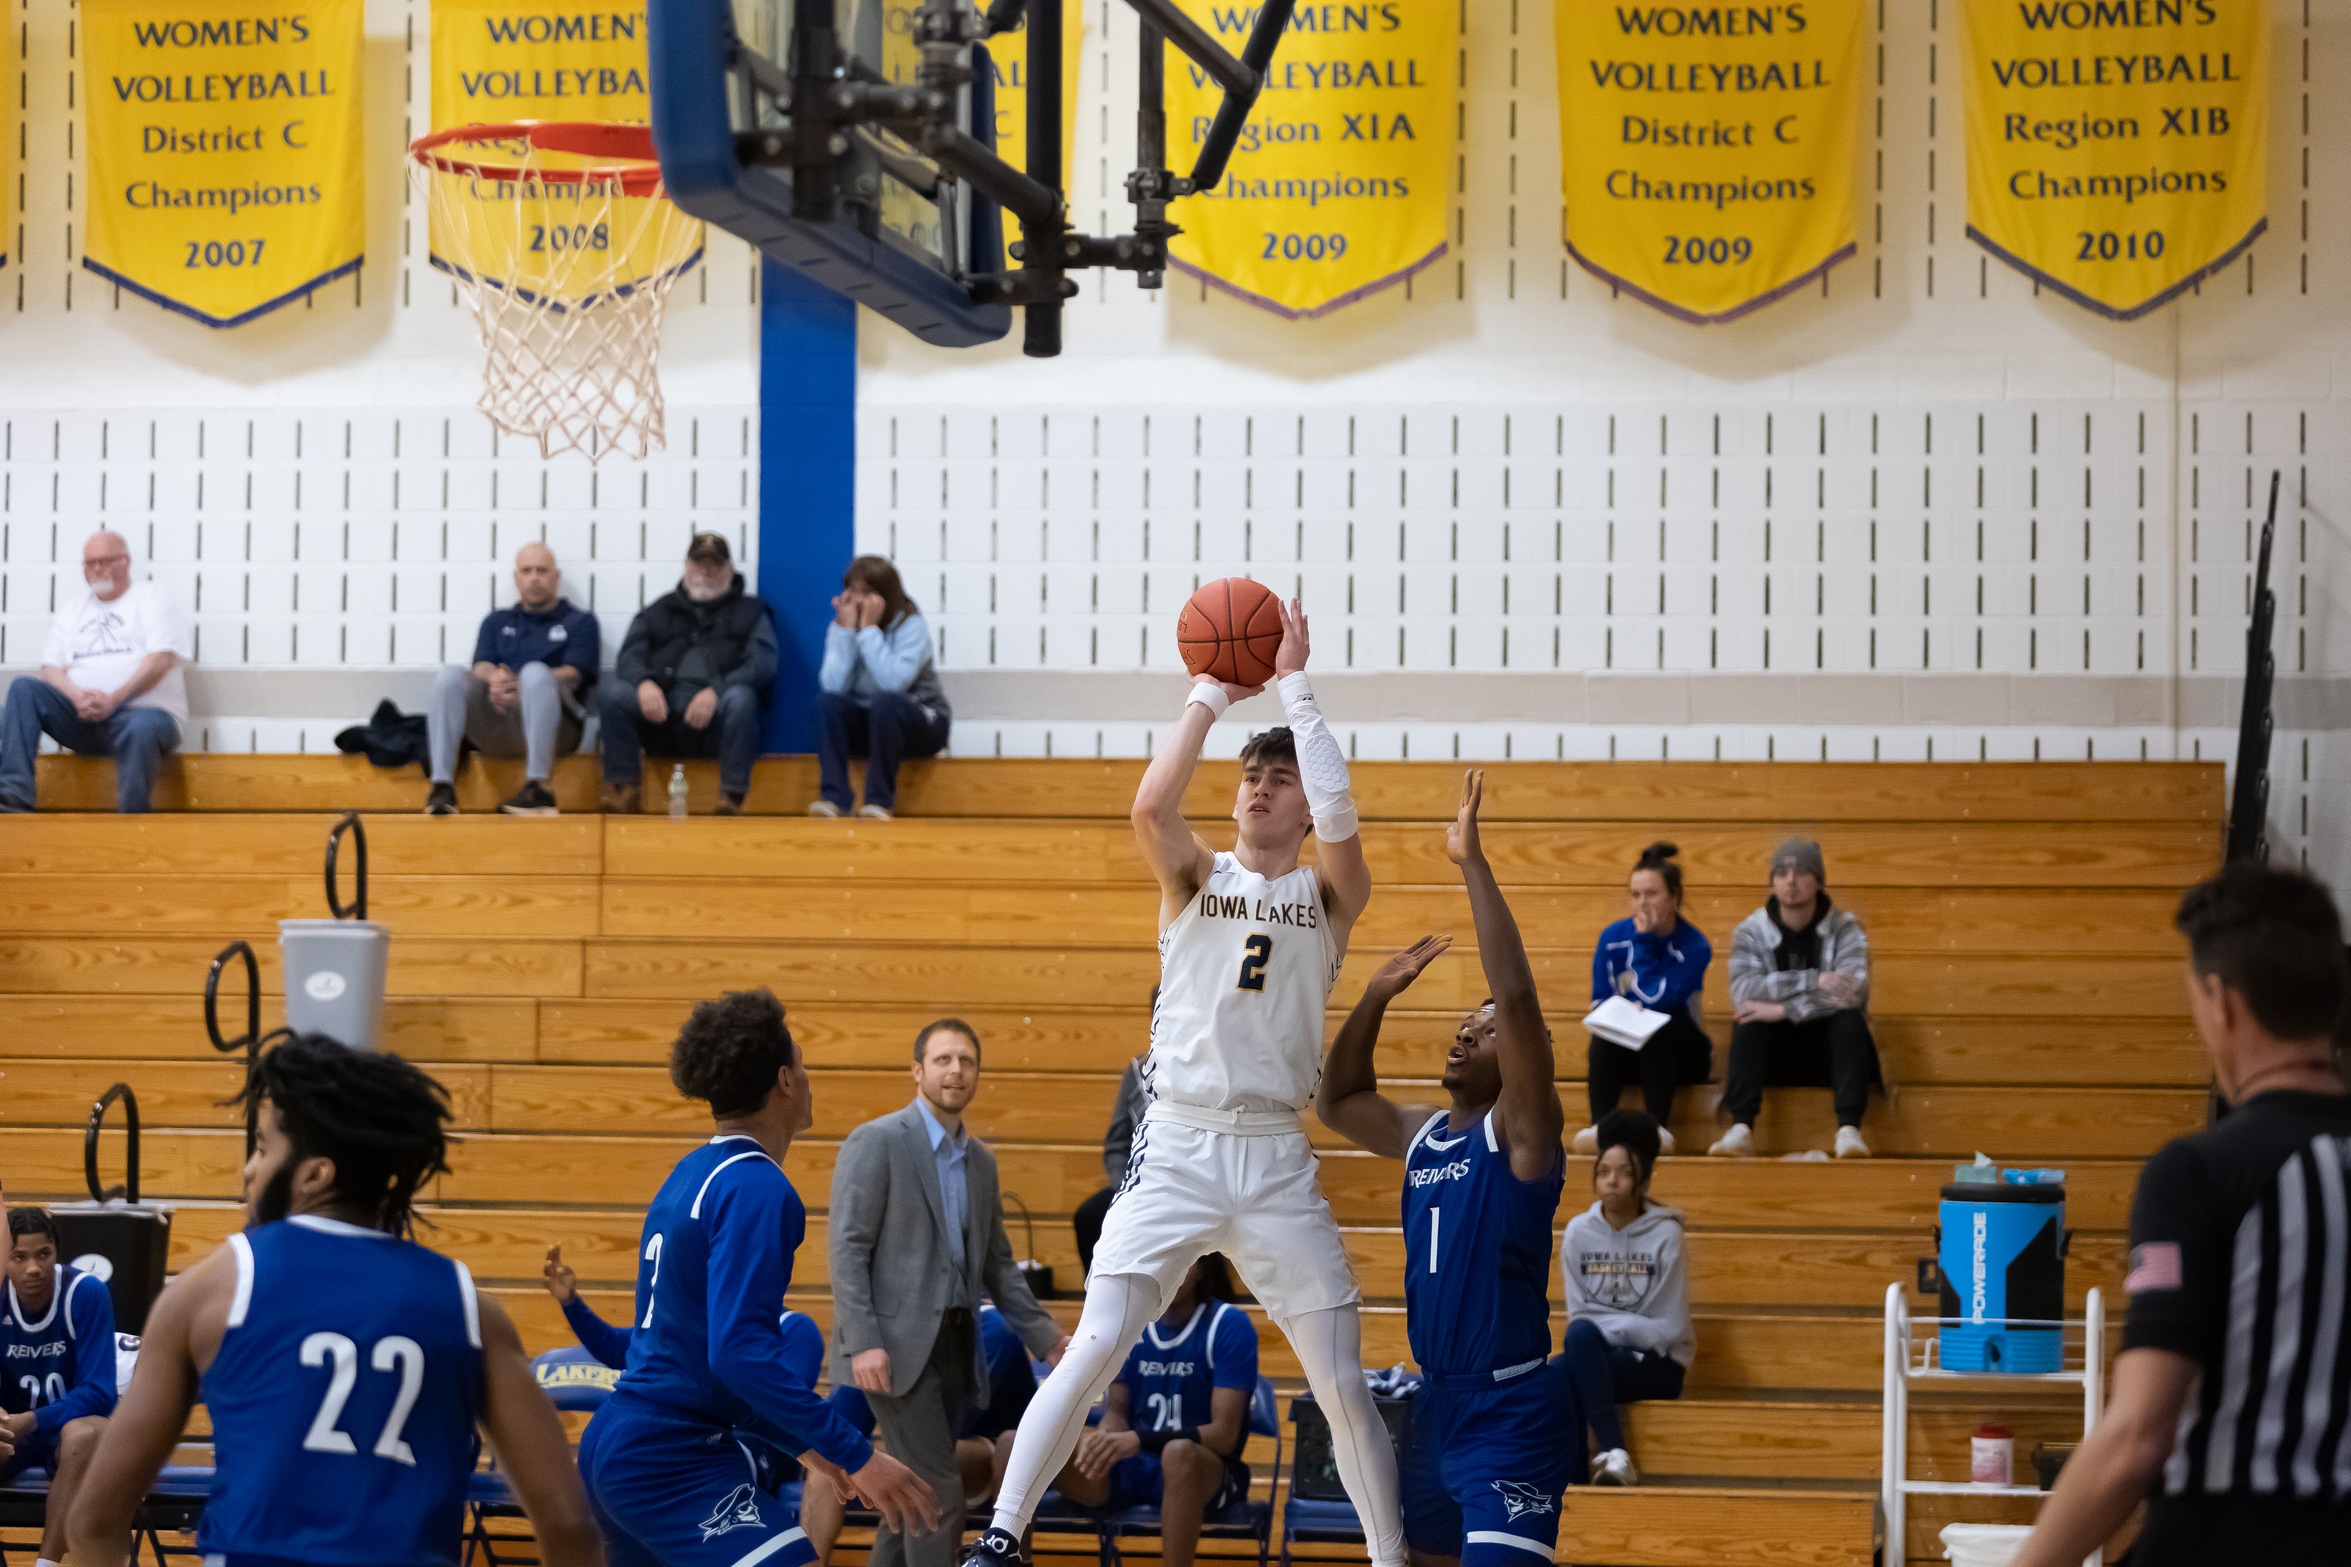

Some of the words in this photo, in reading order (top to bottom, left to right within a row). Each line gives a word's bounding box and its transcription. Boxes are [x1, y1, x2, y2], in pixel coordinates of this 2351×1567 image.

[134, 15, 309, 48] WOMEN'S
[486, 13, 649, 43] WOMEN'
[1213, 3, 1401, 34] WMEN'S
[1616, 3, 1807, 36] WOMEN'S
[2019, 0, 2217, 30] WOMEN'S
[112, 69, 335, 102] VOLLEYBALL
[461, 68, 648, 98] VOLLEYBA
[1188, 59, 1425, 90] VLEYBALL
[1590, 60, 1831, 92] VOLLEYBALL
[1991, 53, 2241, 88] VOLLEYBALL
[143, 125, 264, 153] District
[283, 120, 309, 148] C
[1192, 115, 1320, 152] Rgion
[1341, 113, 1416, 142] XIA
[1622, 115, 1755, 146] District
[1774, 114, 1800, 143] C
[2005, 112, 2140, 149] Region
[2160, 107, 2231, 137] XIB
[126, 181, 321, 215] Champions
[1606, 170, 1816, 210] Champions
[2008, 167, 2228, 203] Champions
[185, 239, 266, 268] 2007
[530, 222, 609, 252] 2008
[1261, 232, 1348, 261] 2009
[1663, 235, 1753, 264] 2009
[2076, 230, 2165, 261] 2010
[1200, 894, 1248, 920] IOWA
[1255, 899, 1317, 929] LAKES
[1235, 932, 1274, 993] 2
[1429, 1207, 1440, 1273] 1
[1972, 1211, 1987, 1325] POWERADE
[299, 1331, 425, 1467] 22
[1147, 1392, 1183, 1432] 24
